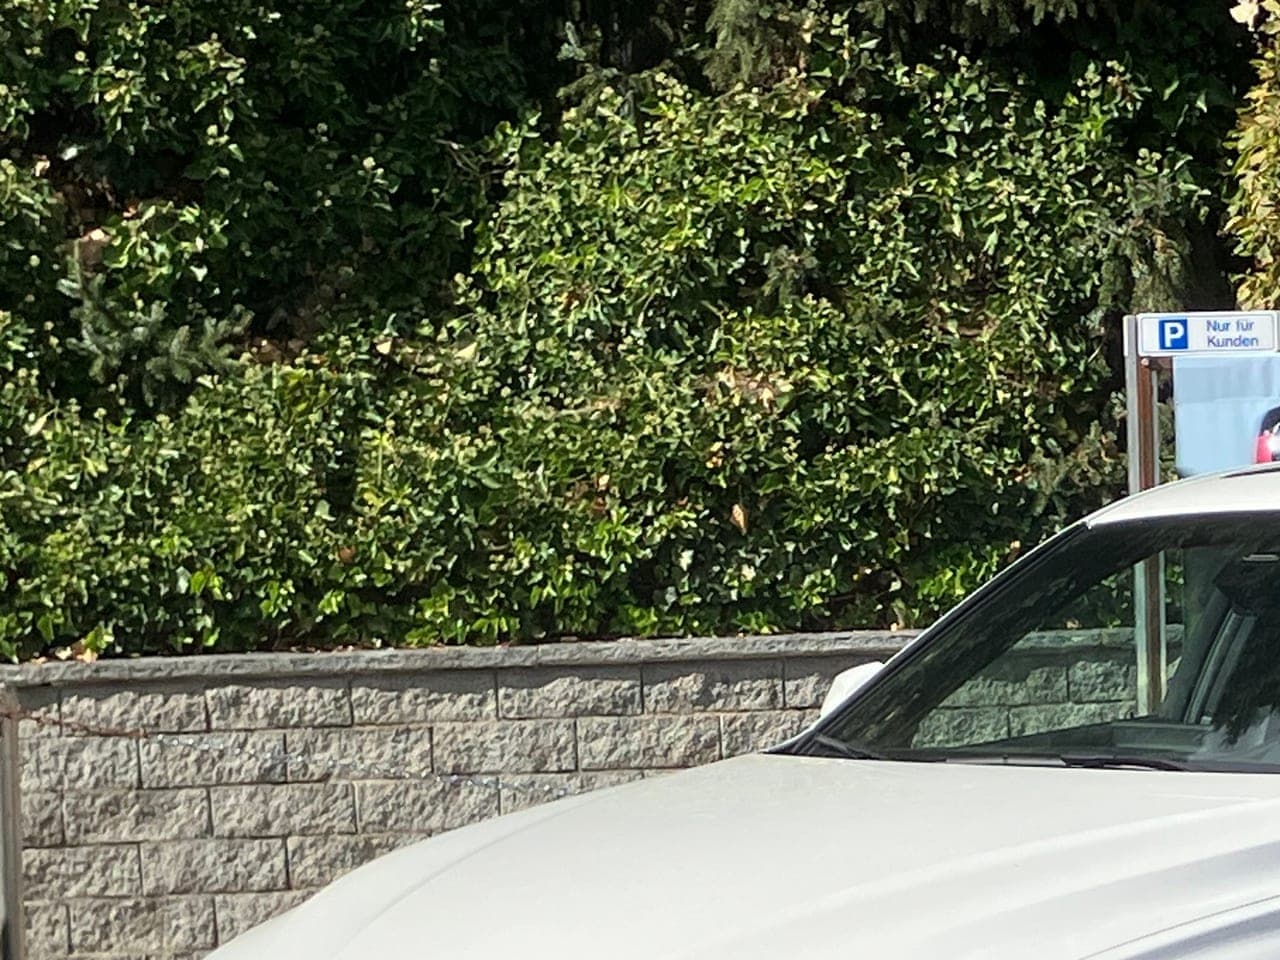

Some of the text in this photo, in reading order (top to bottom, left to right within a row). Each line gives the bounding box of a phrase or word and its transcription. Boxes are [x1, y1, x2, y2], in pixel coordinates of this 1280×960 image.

[1206, 319, 1255, 332] Nur für
[1164, 322, 1185, 348] P
[1206, 335, 1259, 348] Kunden
